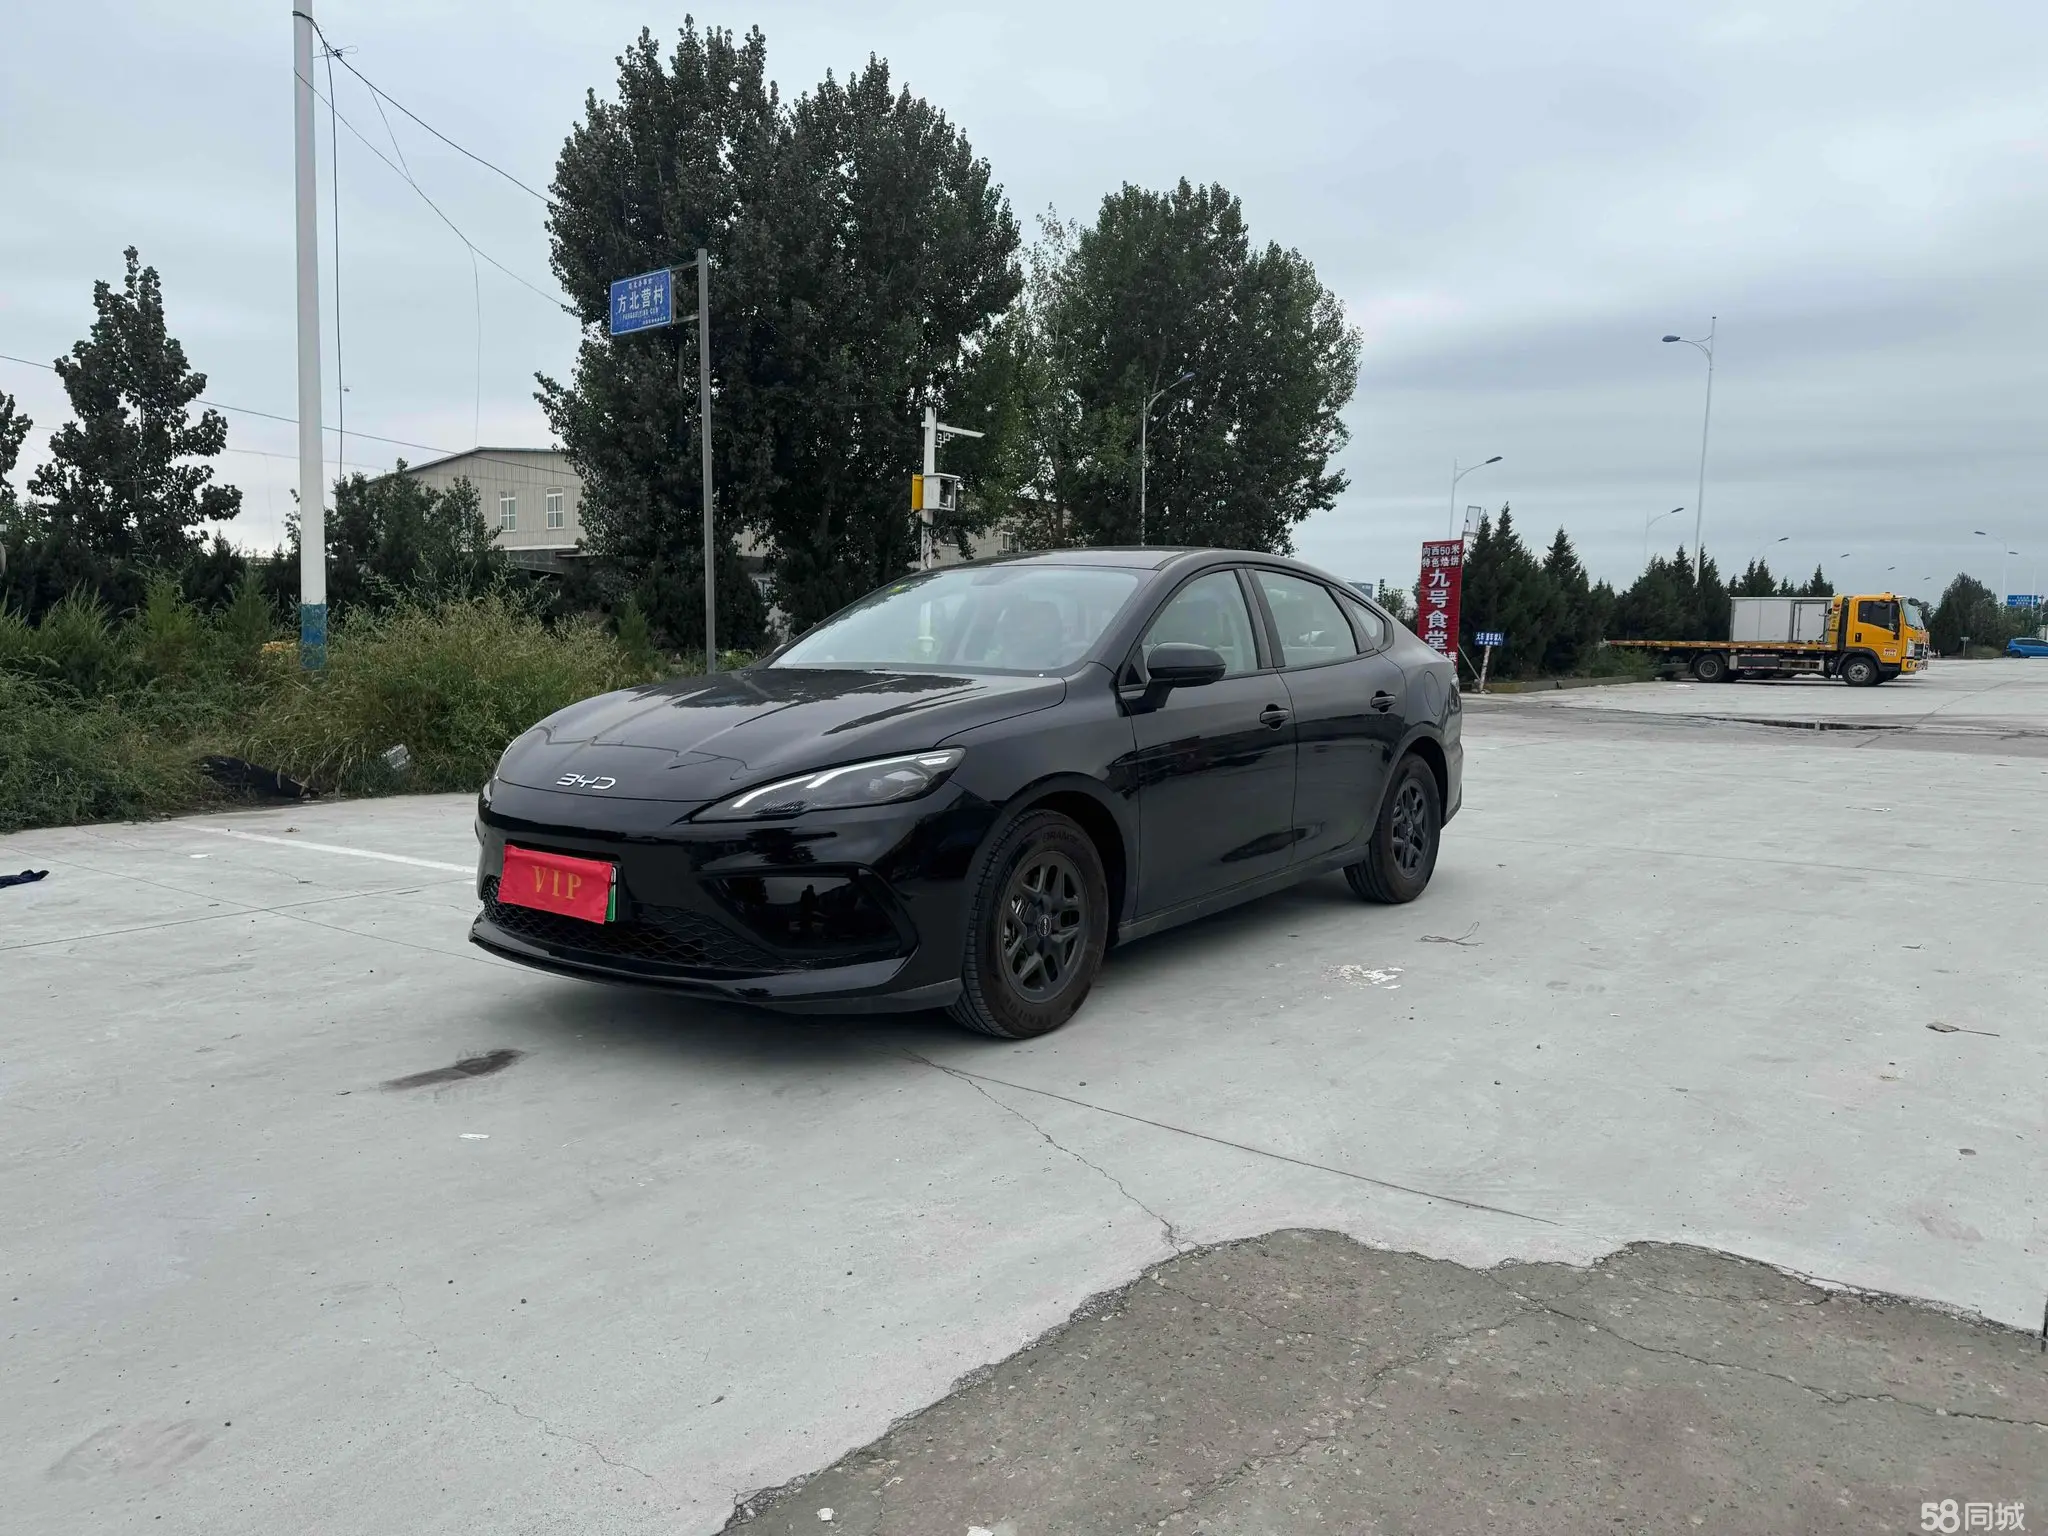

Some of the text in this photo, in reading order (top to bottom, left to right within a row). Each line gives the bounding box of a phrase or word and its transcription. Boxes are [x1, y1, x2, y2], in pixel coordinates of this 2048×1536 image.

[617, 284, 664, 313] 方北营村
[1422, 544, 1460, 557] 向西50米
[1424, 568, 1451, 650] 九号食堂
[556, 773, 616, 790] BYD
[532, 865, 582, 900] VIP
